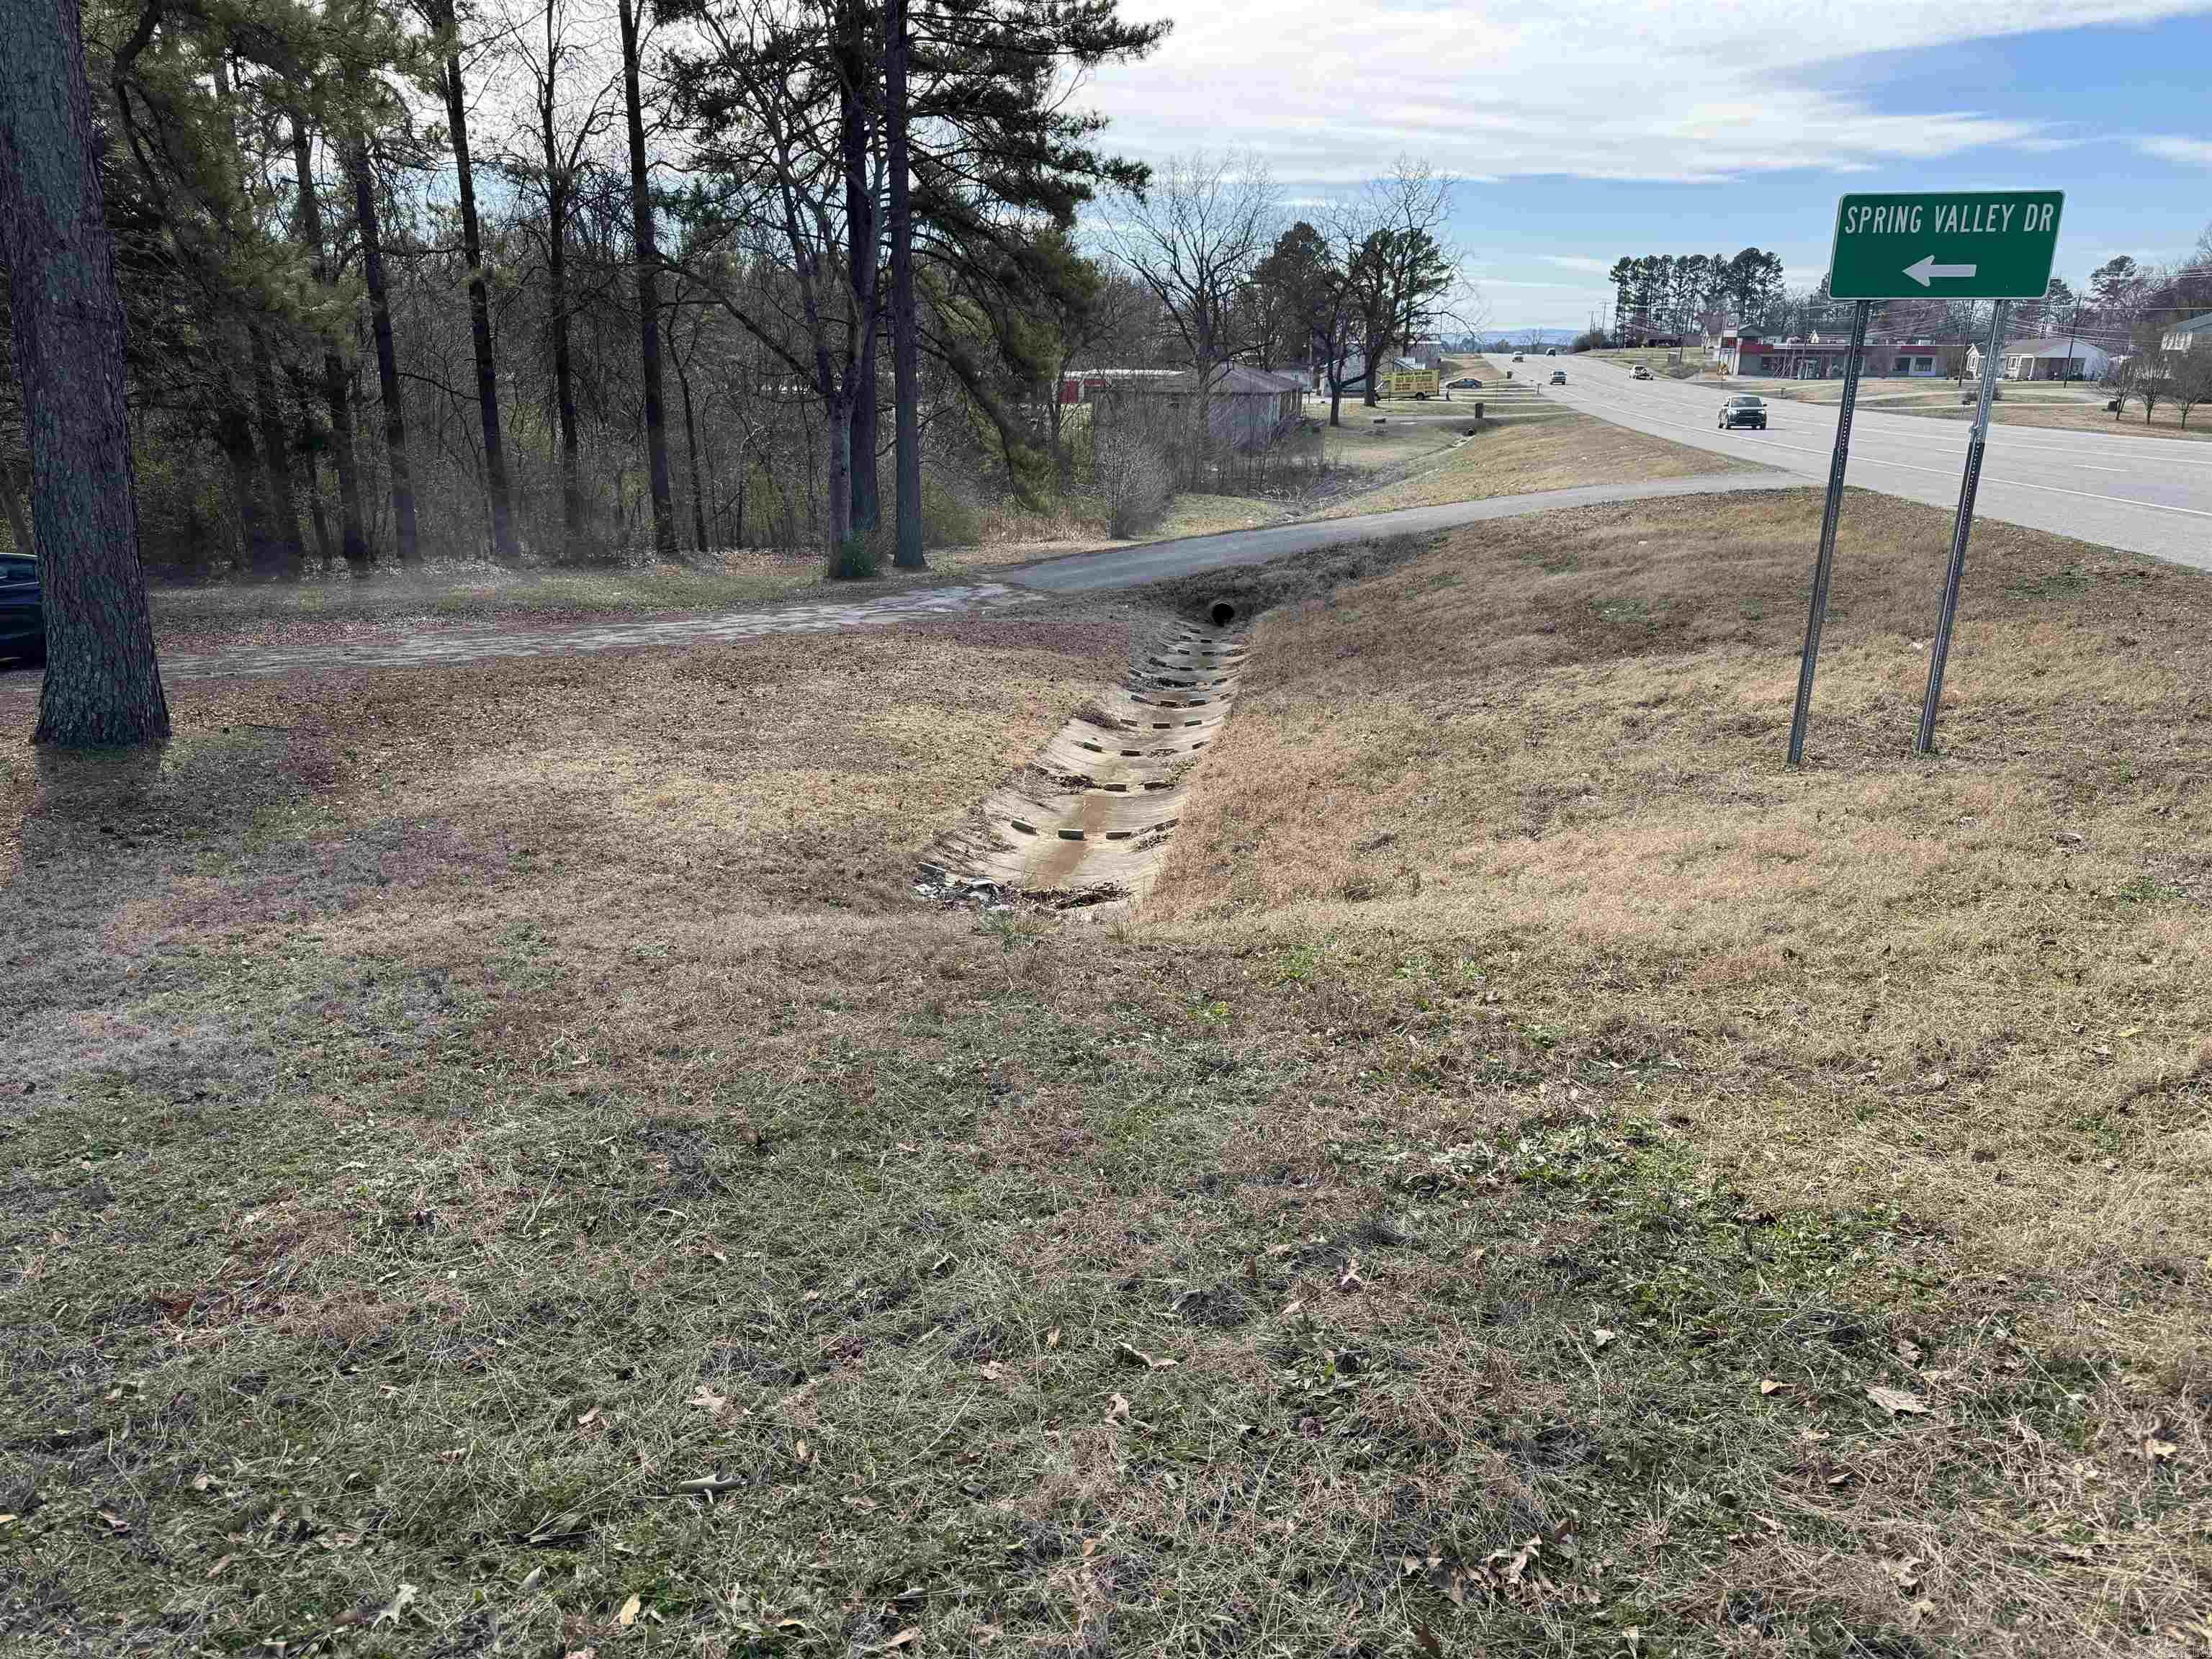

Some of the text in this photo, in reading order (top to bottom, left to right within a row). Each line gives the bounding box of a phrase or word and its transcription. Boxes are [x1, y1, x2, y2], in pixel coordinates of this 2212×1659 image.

[1845, 203, 2054, 234] SPRING VALLEY DR
